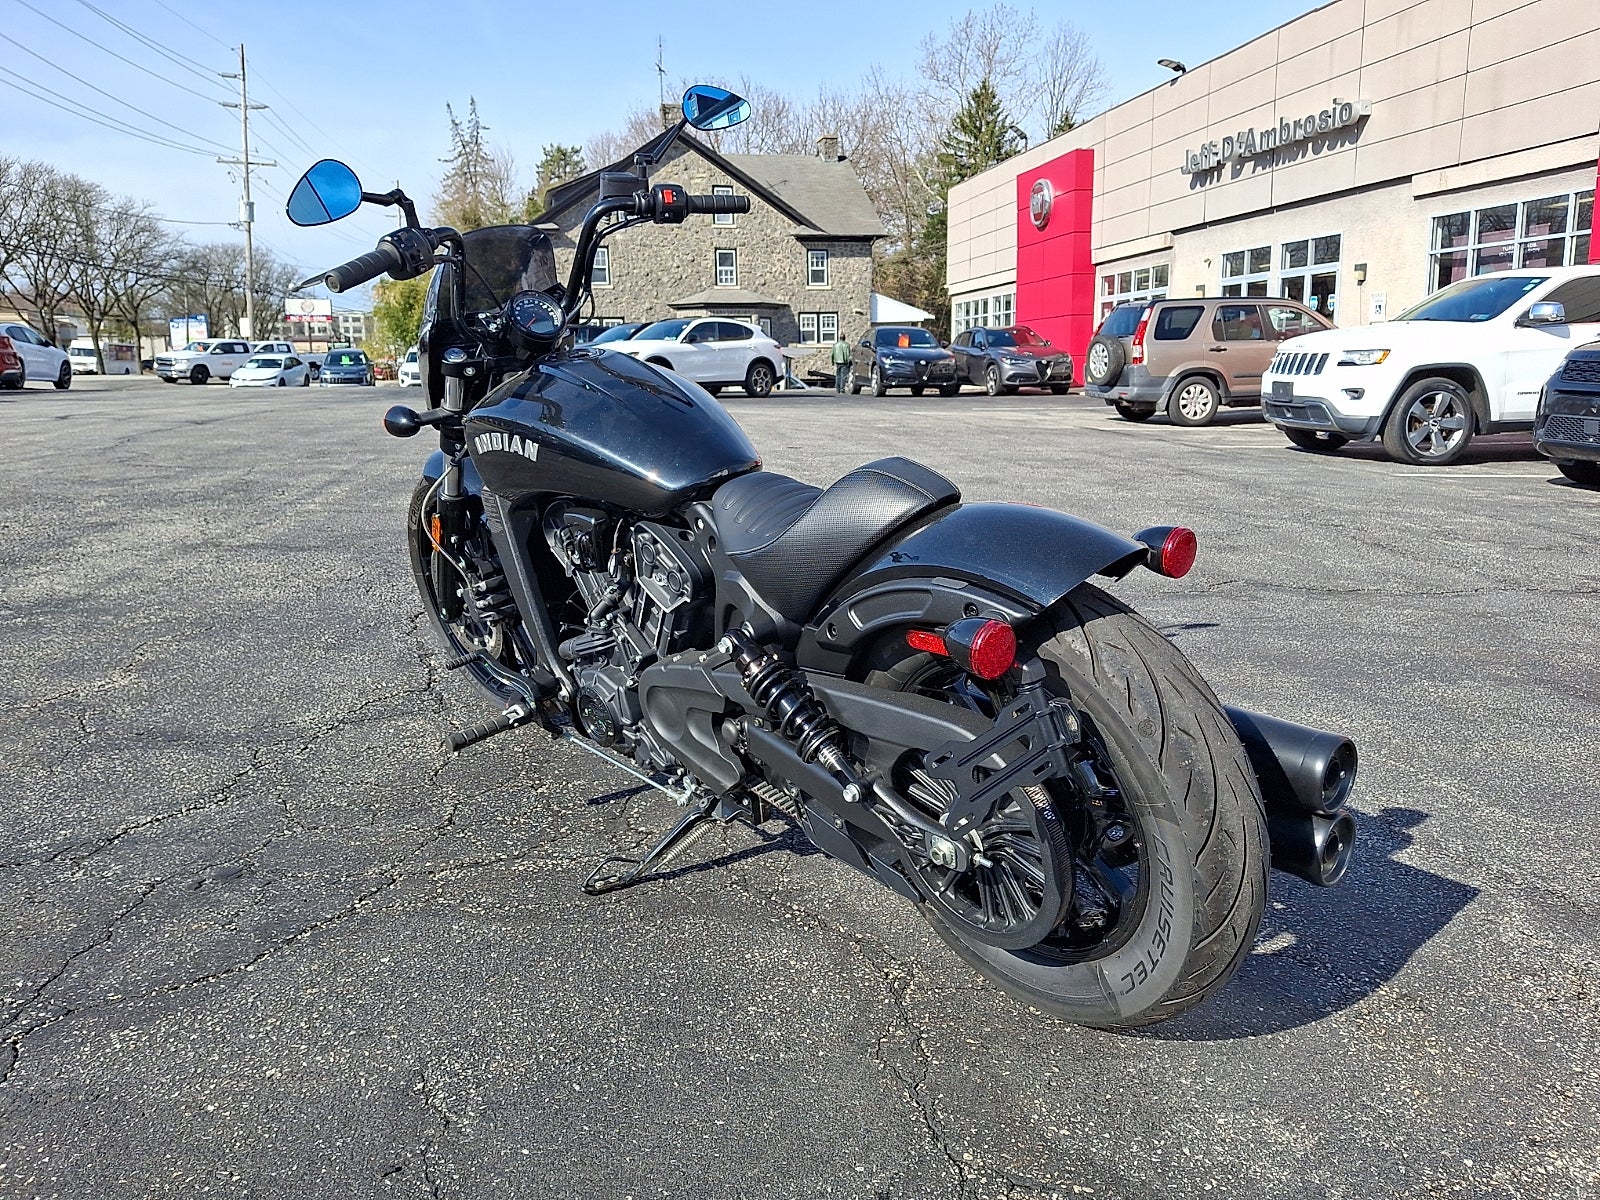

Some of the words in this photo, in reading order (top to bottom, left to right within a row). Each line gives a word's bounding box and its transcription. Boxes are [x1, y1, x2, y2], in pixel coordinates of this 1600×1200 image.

[1181, 141, 1219, 175] Jeff
[1221, 98, 1355, 163] D'Ambrosio
[474, 432, 539, 462] INDIAN
[1120, 833, 1175, 996] CRUISETEC
